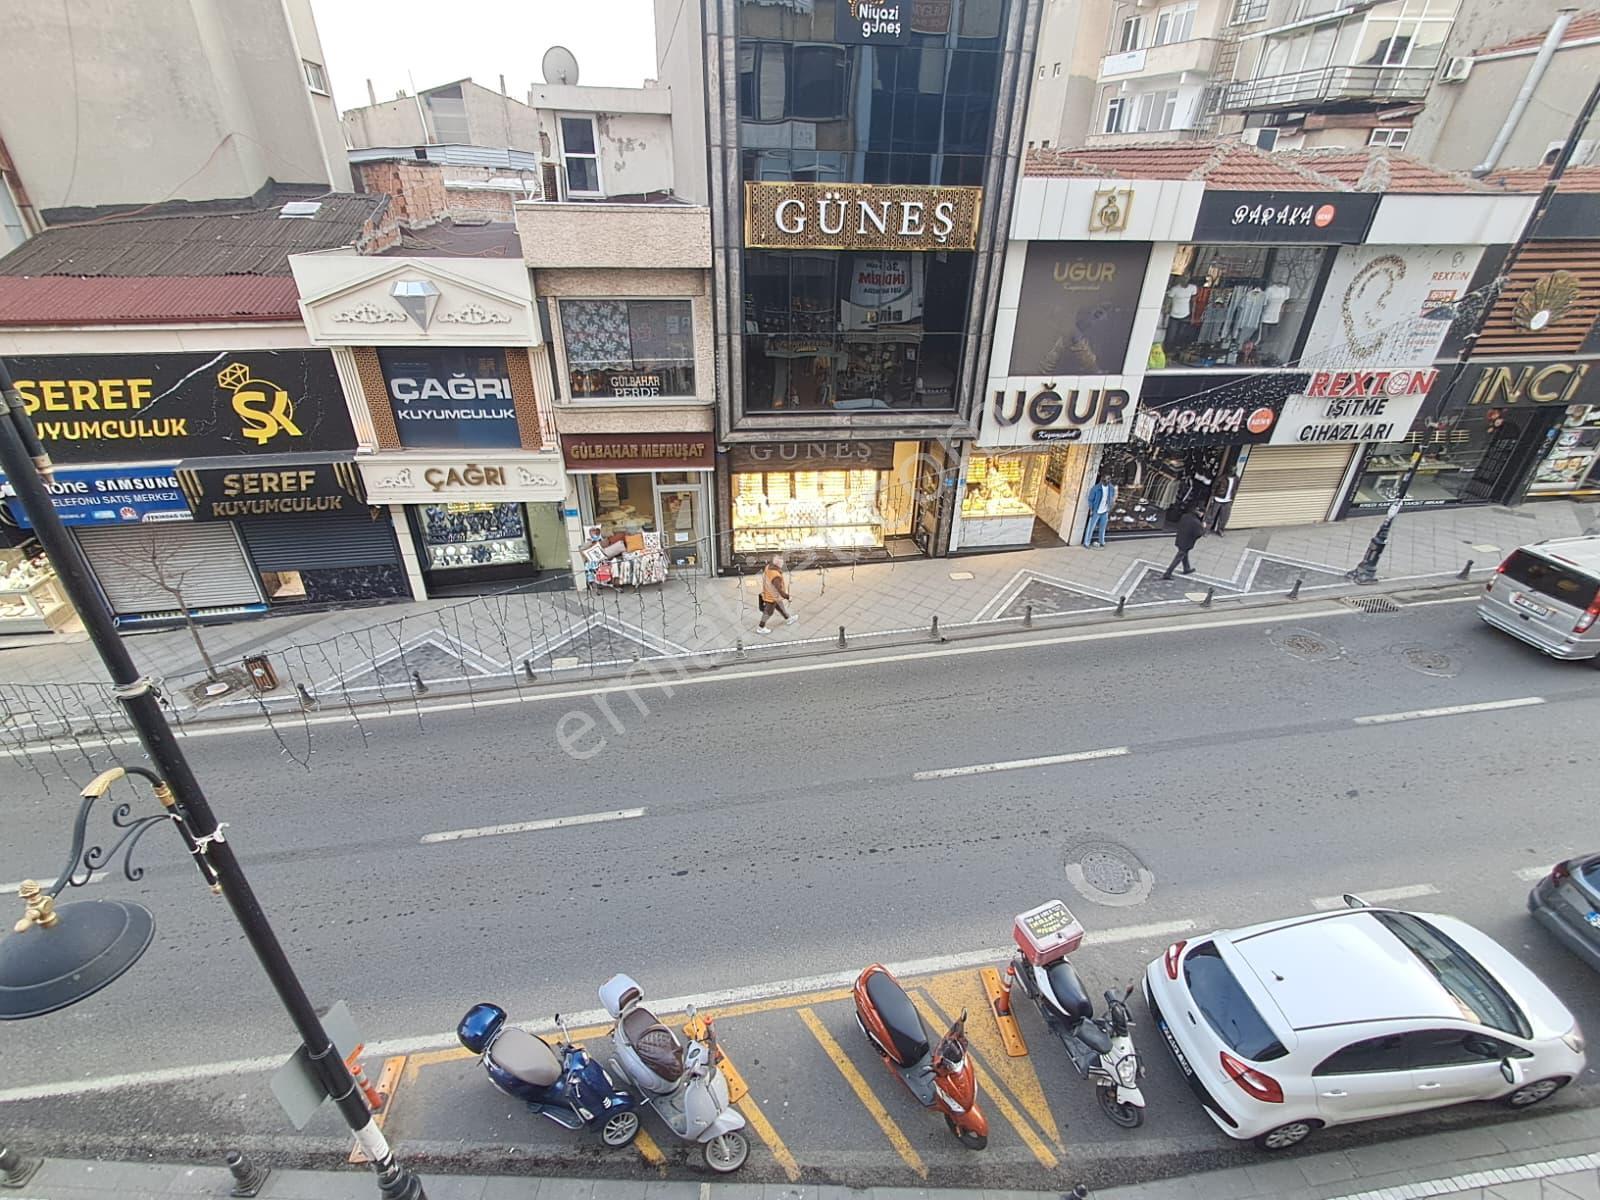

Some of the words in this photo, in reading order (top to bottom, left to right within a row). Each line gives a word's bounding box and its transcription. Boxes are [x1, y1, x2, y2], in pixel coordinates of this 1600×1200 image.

[859, 3, 899, 24] Niyazi
[774, 192, 955, 243] GÜNEŞ
[1231, 204, 1314, 227] BARAKA
[1431, 271, 1471, 281] REXTON
[390, 372, 513, 404] ÇAĞRI
[610, 375, 660, 387] GÜLBAHAR
[1308, 370, 1437, 397] REXTON
[13, 378, 153, 416] ŞEREF
[614, 387, 660, 398] PERDE
[994, 382, 1130, 425] UĞUR
[1326, 399, 1389, 418] İŞİTME
[398, 409, 516, 420] KUYUMCULUK
[36, 417, 188, 441] UYUMCULUK
[1300, 423, 1394, 441] CİHAZLARI
[570, 441, 638, 459] GÜLBAHAR
[641, 443, 705, 460] MEFRUŞAT
[95, 476, 179, 492] SAMSUNG
[223, 470, 316, 497] ŞEREF
[424, 464, 507, 492] ÇAĞRI
[52, 496, 101, 507] ELEFONU
[103, 495, 132, 506] SATIŞ
[134, 492, 178, 503] MERKEZİ
[212, 496, 343, 517] KUYUMCULUK
